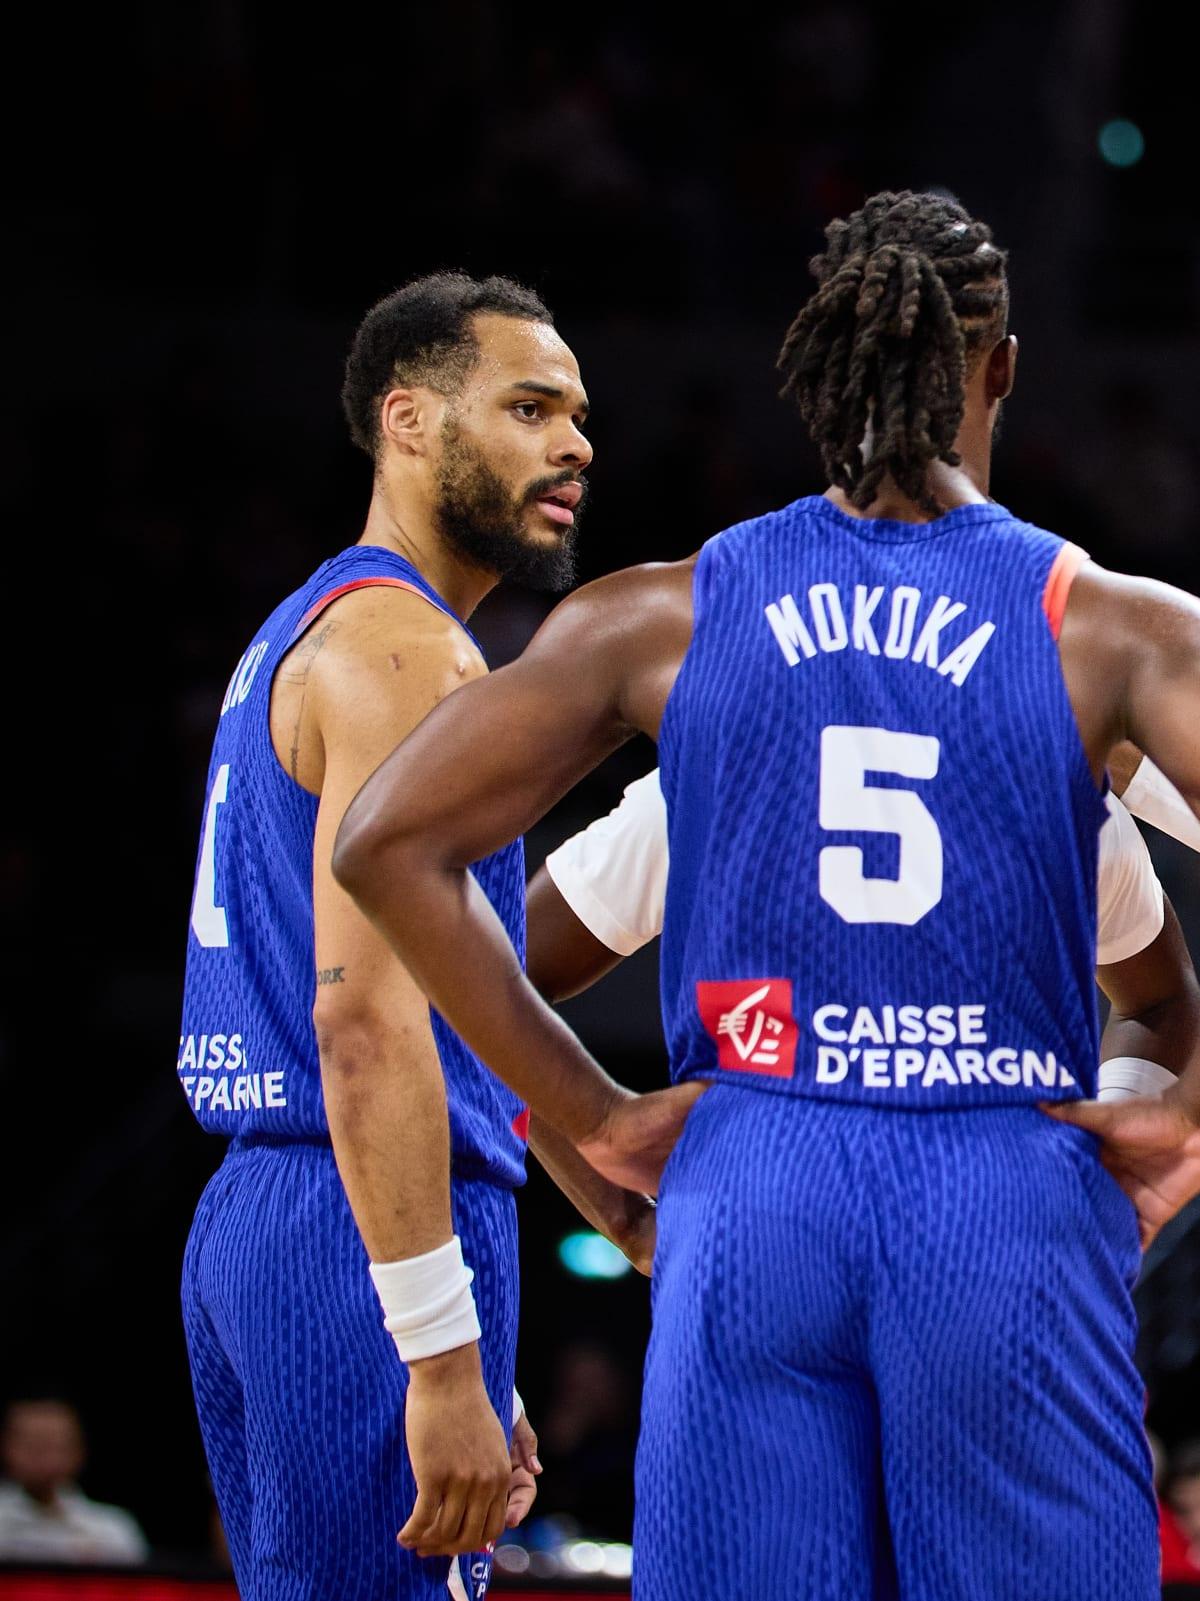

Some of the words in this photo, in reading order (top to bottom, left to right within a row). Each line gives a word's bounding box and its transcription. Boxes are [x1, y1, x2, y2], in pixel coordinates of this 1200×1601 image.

[764, 583, 997, 688] MOKOKA
[818, 725, 943, 926] 5
[177, 1033, 248, 1070] AISS
[813, 1003, 987, 1045] CAISSE
